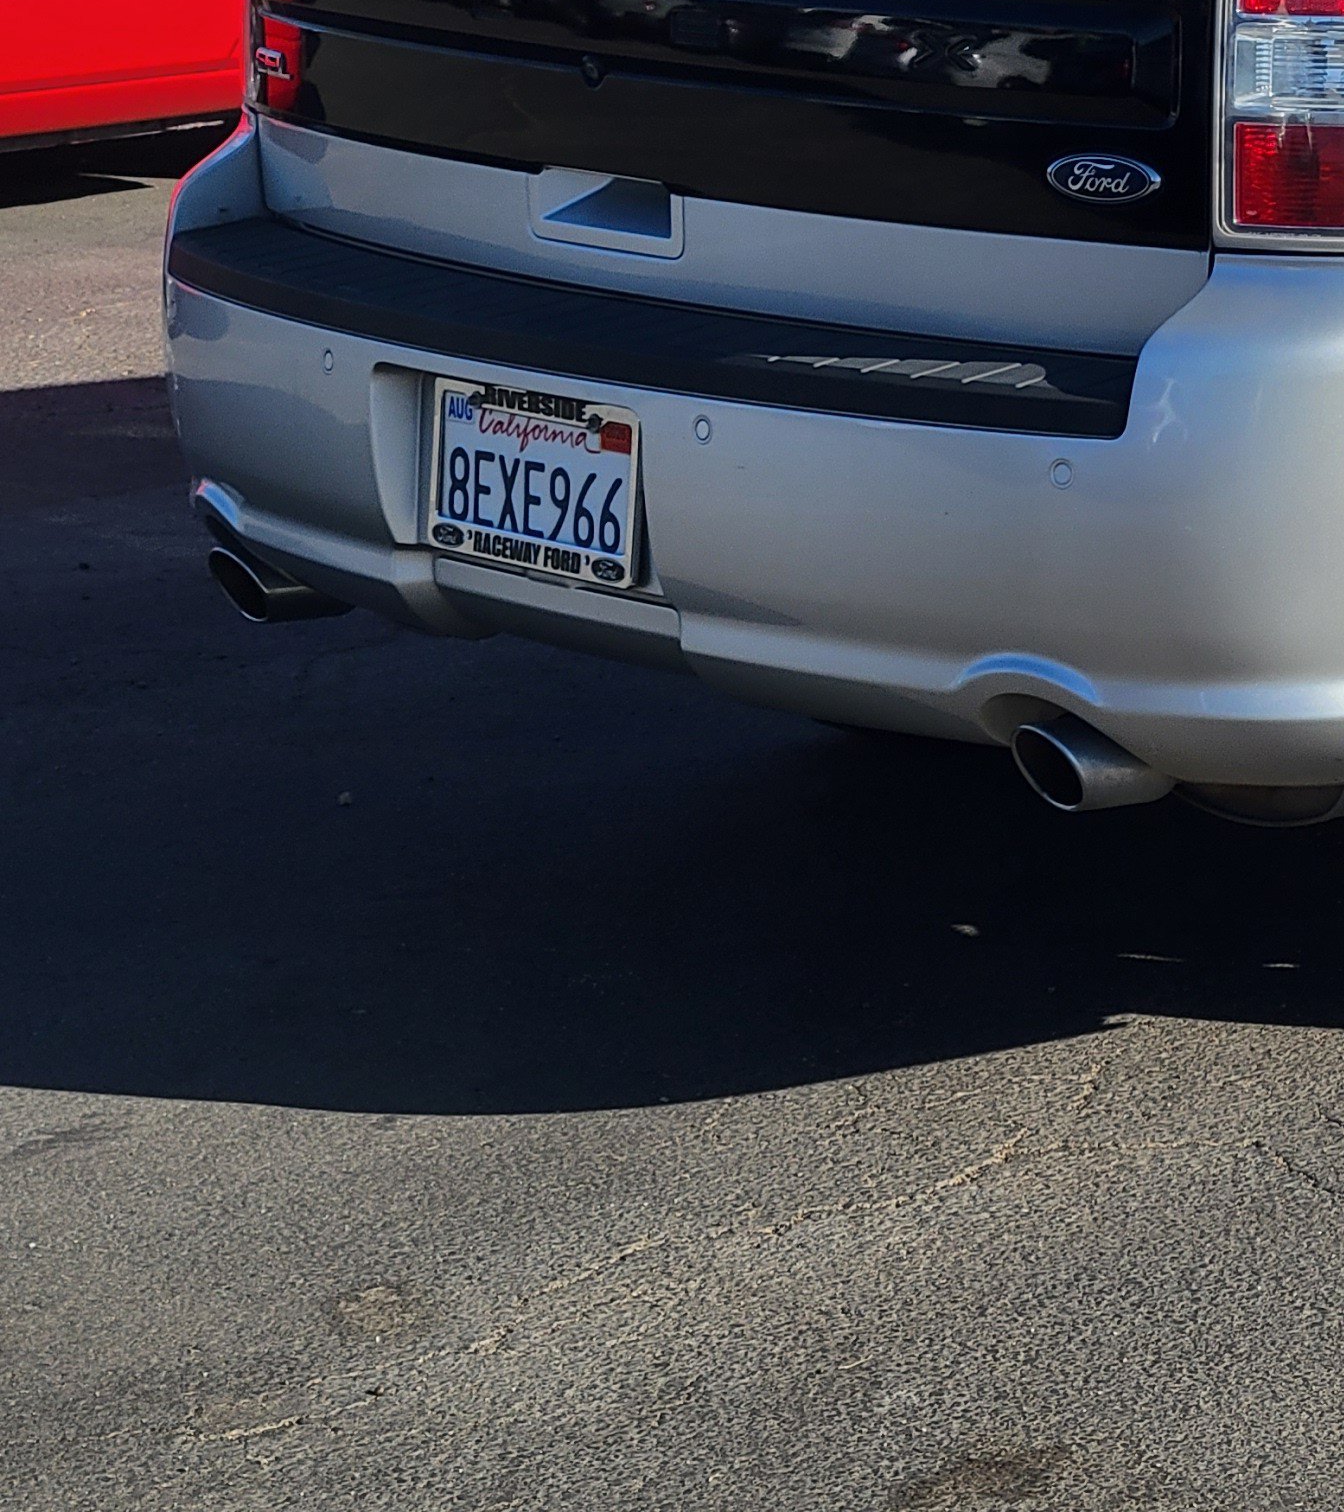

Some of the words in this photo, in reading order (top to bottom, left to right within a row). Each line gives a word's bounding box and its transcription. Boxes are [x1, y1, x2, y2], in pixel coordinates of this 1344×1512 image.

[1067, 161, 1131, 194] Ford
[448, 395, 473, 421] AUG
[484, 386, 587, 422] RIVERSIDE
[478, 406, 602, 453] California
[448, 446, 623, 554] 8EXE966
